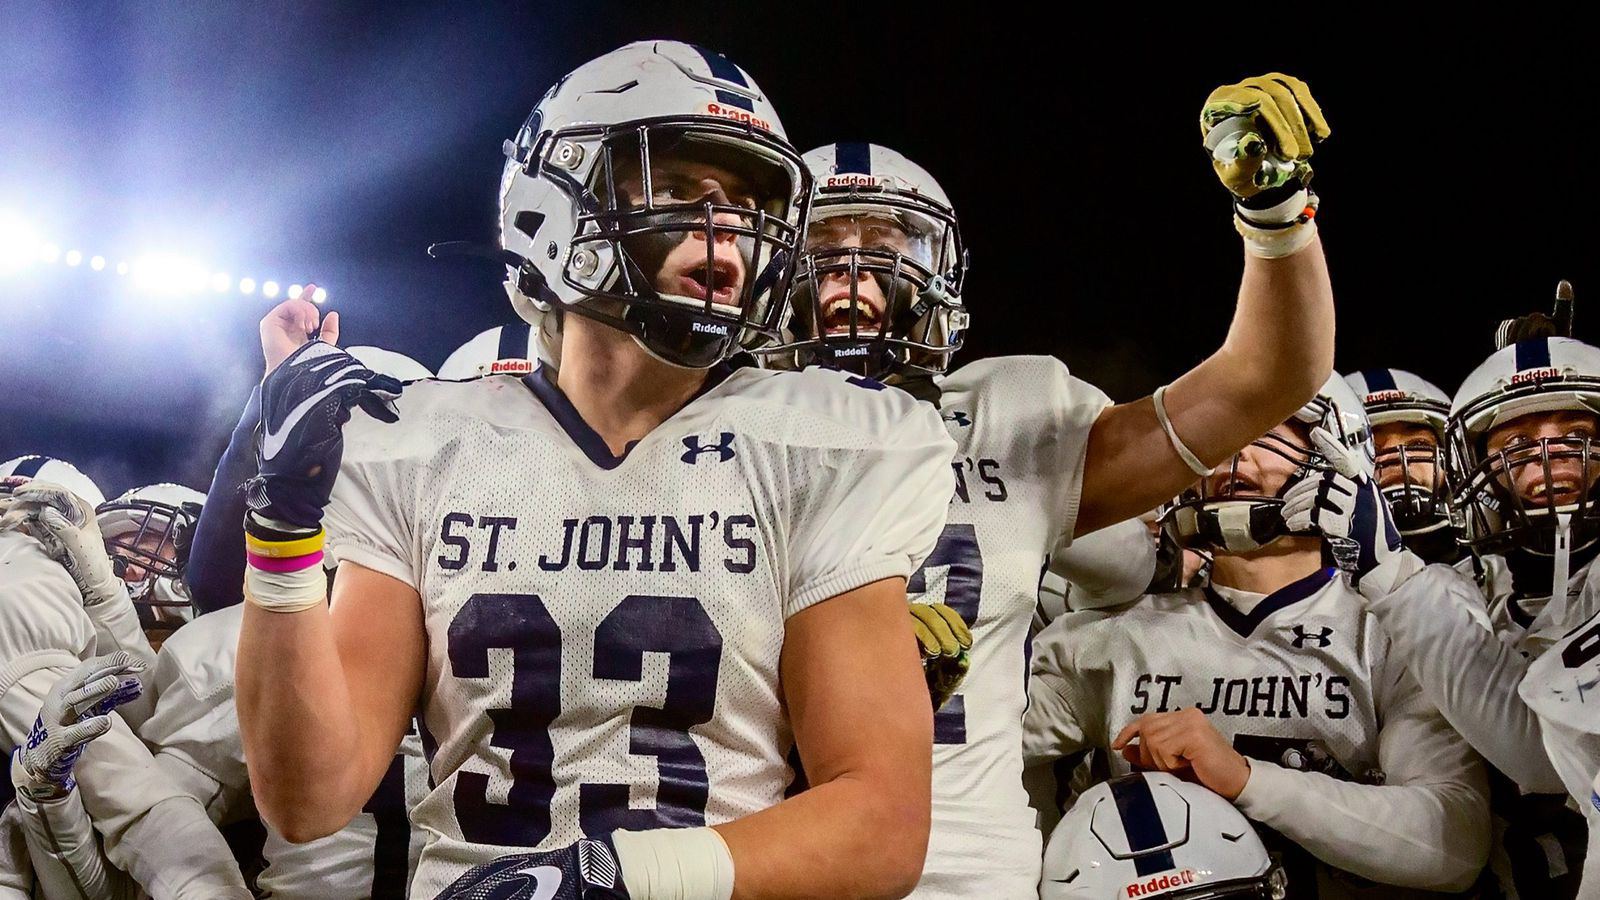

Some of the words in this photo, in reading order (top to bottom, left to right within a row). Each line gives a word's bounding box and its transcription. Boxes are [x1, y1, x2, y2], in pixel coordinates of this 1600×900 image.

[707, 103, 770, 129] Riddell
[827, 176, 875, 187] Riddell
[692, 322, 727, 335] Riddell
[834, 347, 867, 357] Riddell
[491, 361, 532, 373] Riddell
[1511, 368, 1558, 385] Riddell
[437, 512, 518, 573] ST.
[538, 510, 757, 574] JOHN'S
[1195, 672, 1351, 719] JOHN'S
[447, 593, 724, 848] 33
[1127, 869, 1194, 898] Riddell
